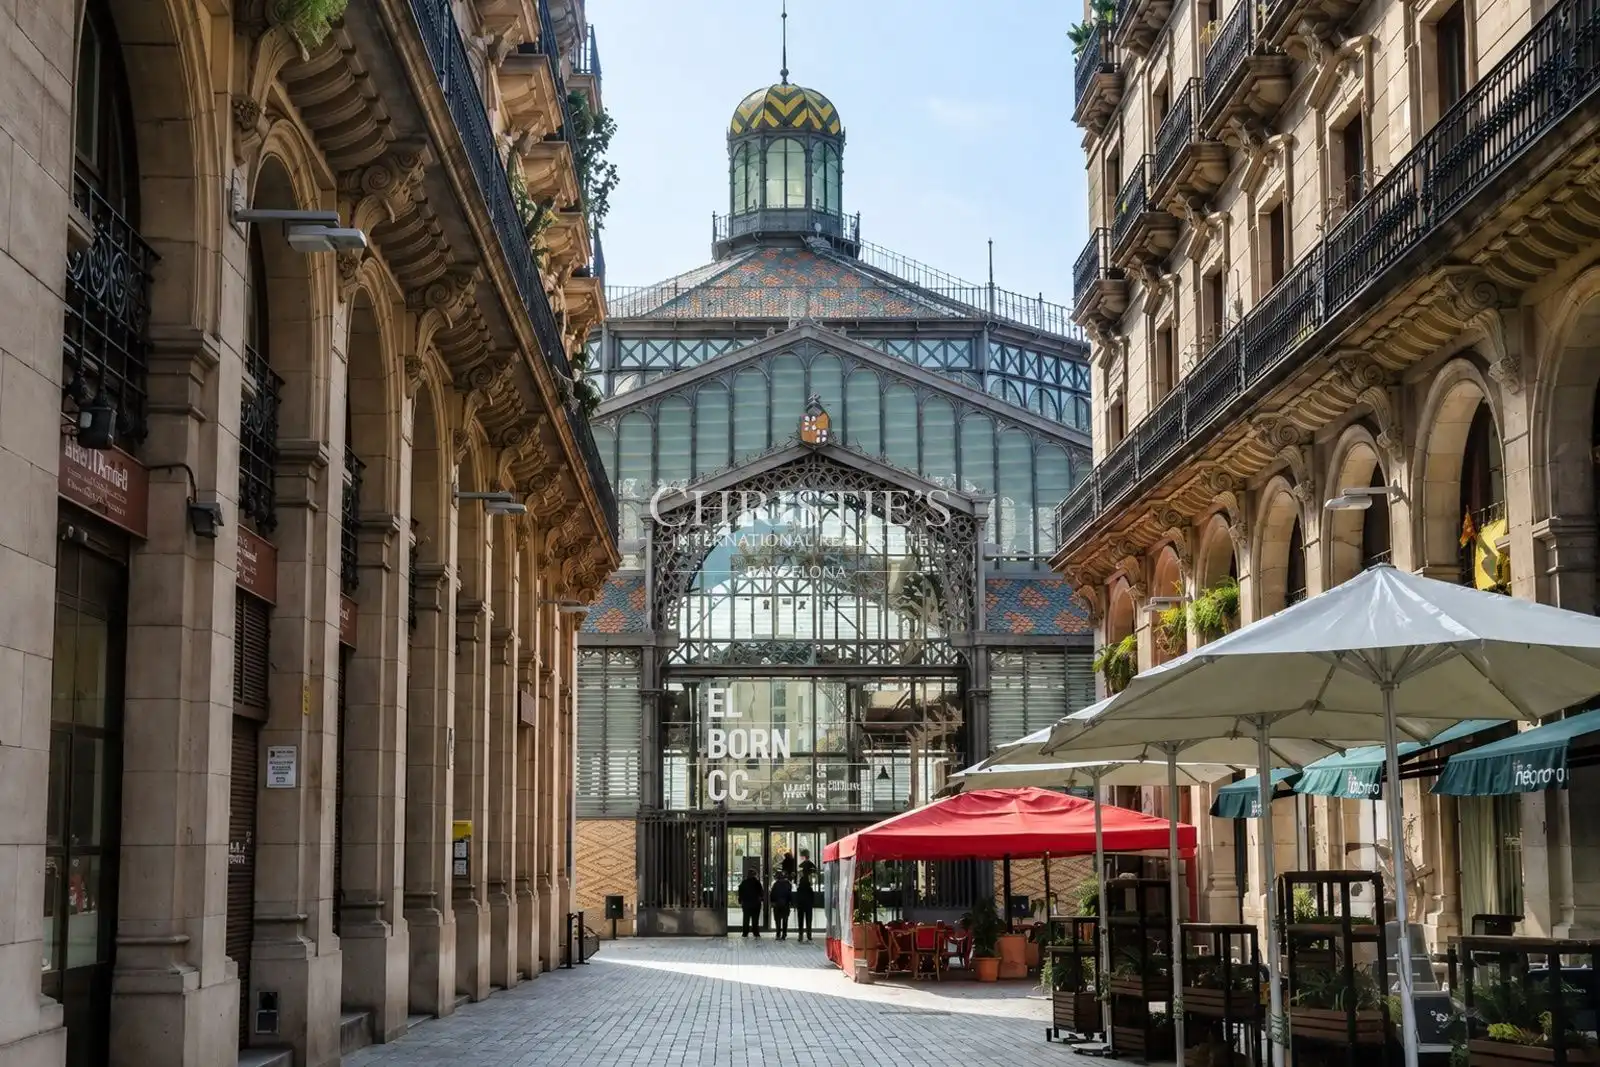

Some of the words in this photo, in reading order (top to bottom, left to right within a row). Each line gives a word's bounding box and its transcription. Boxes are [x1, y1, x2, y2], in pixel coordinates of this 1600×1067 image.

[708, 687, 743, 718] EL
[708, 728, 791, 759] BORN
[708, 769, 749, 801] CC
